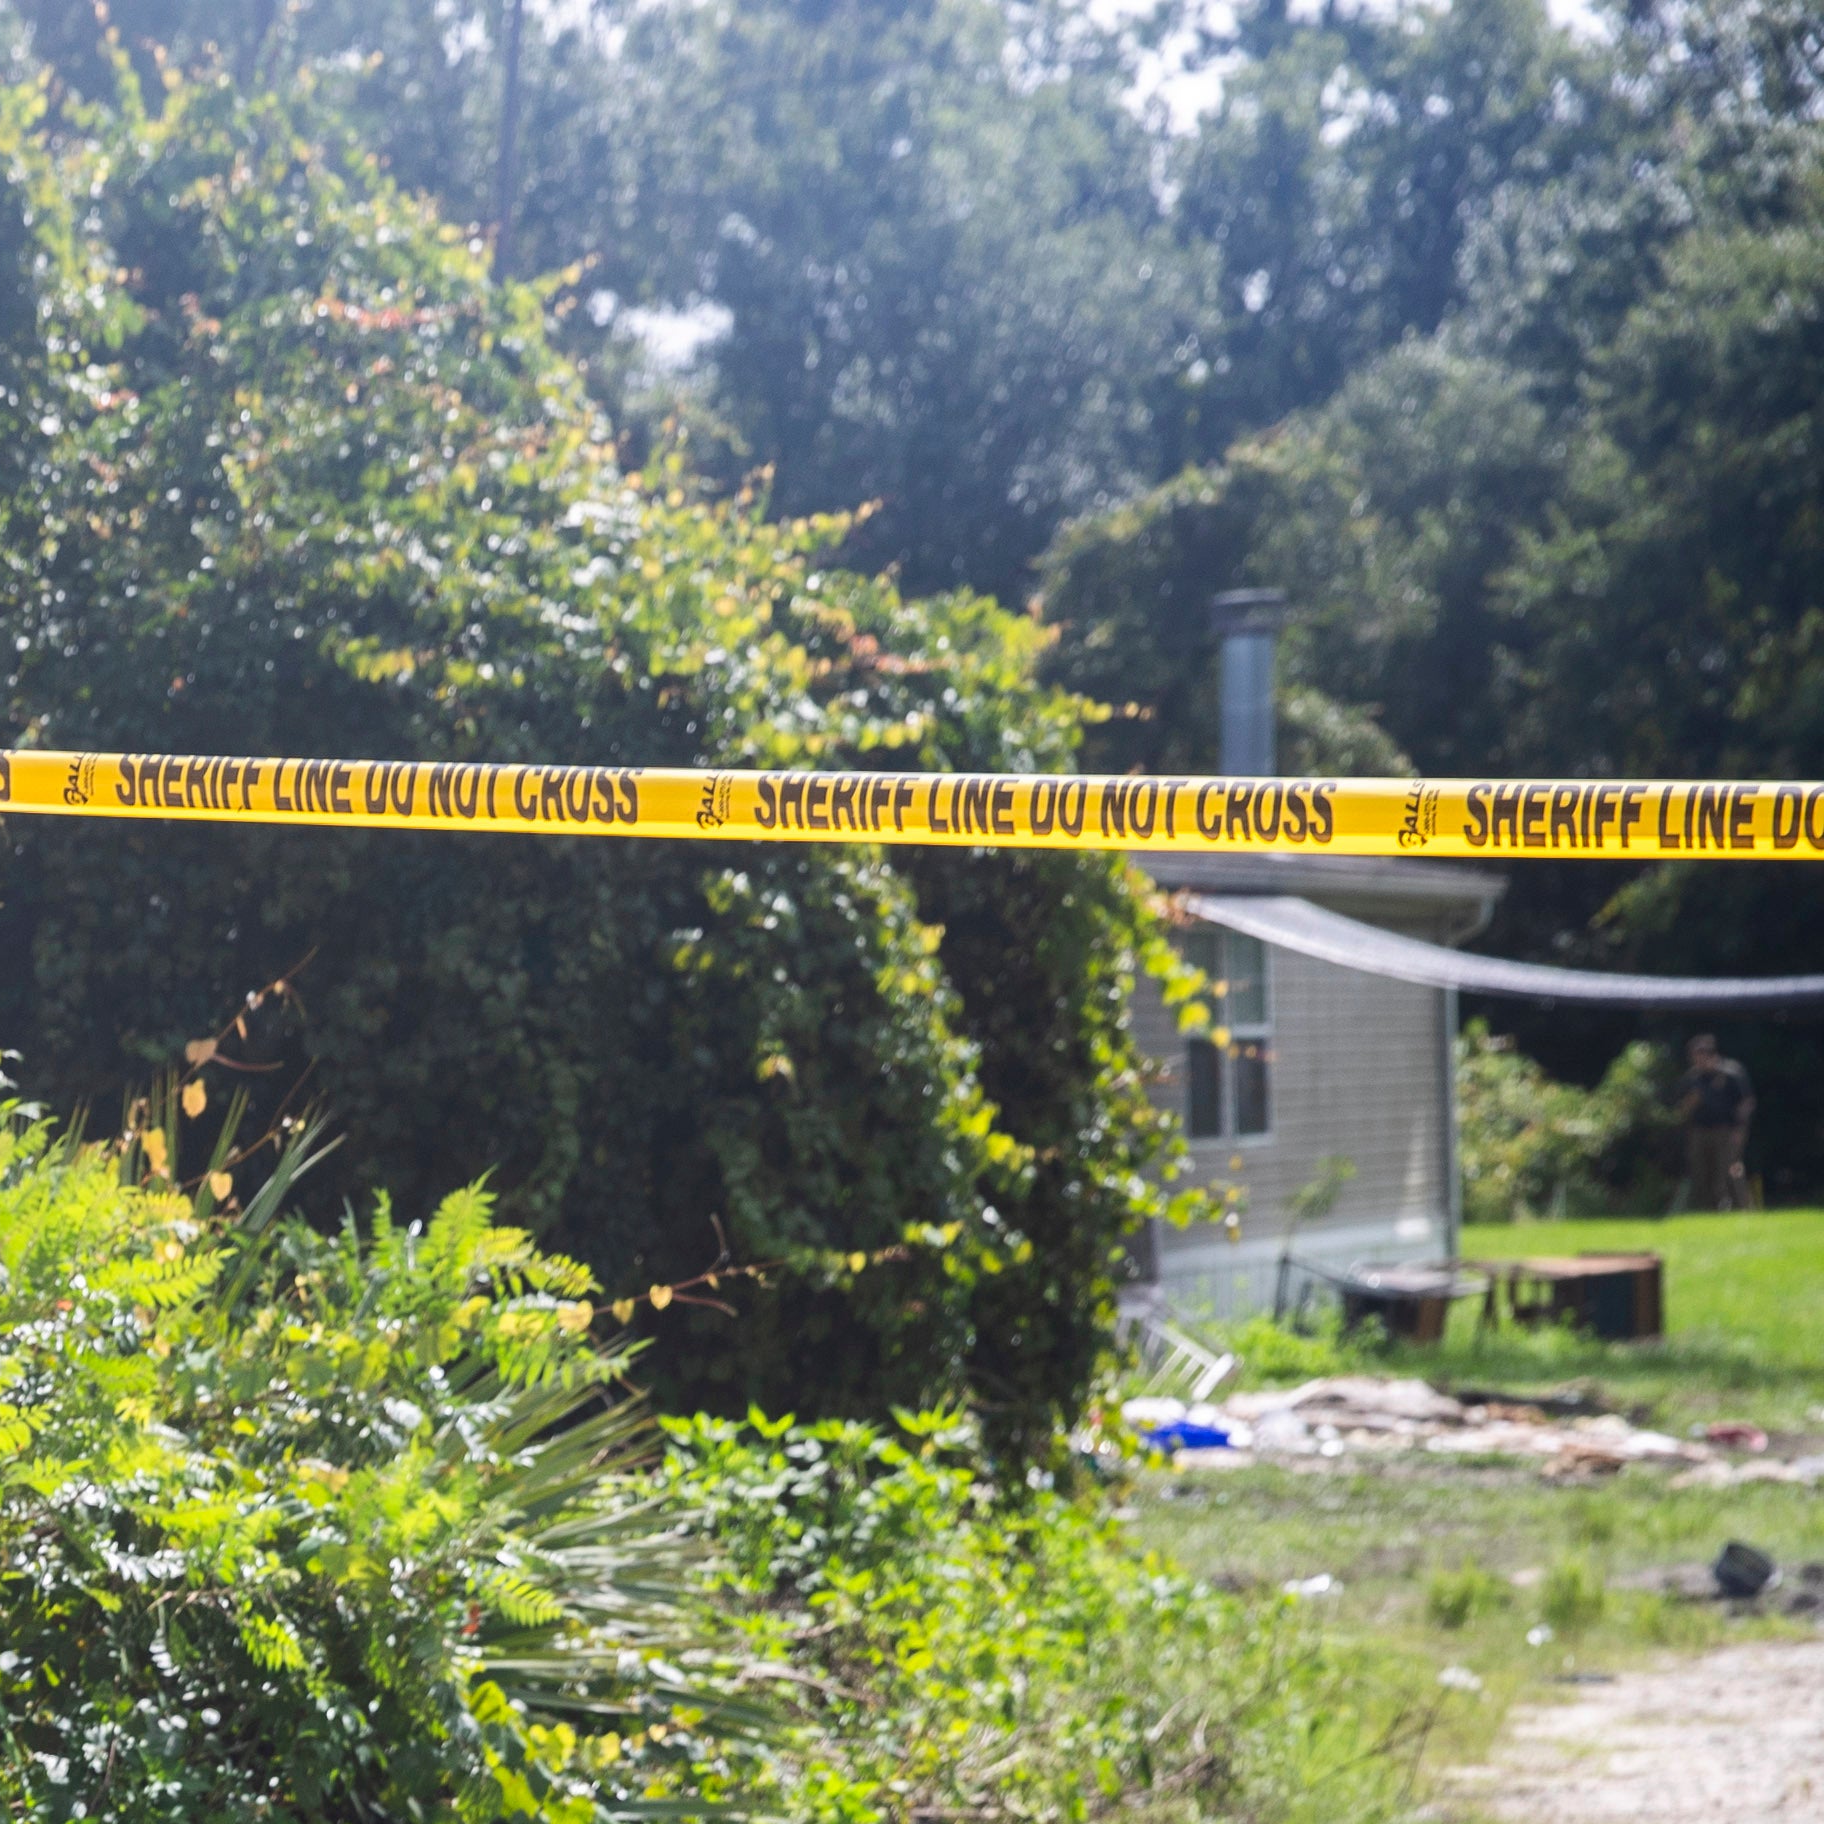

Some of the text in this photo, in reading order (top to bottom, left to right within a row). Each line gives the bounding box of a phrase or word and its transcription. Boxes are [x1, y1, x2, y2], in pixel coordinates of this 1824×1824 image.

[115, 754, 263, 810] SHERIFF
[273, 757, 354, 814] LINE
[364, 761, 418, 817] DO
[428, 763, 502, 819] NOT
[514, 764, 642, 824] CROSS
[754, 774, 921, 833] SHERIFF
[928, 777, 1020, 836] LINE
[1030, 779, 1088, 837] DO
[1102, 779, 1191, 839] NOT
[1196, 779, 1338, 844] CROSS
[1463, 783, 1650, 849] SHERIFF
[1658, 785, 1761, 850] LINE
